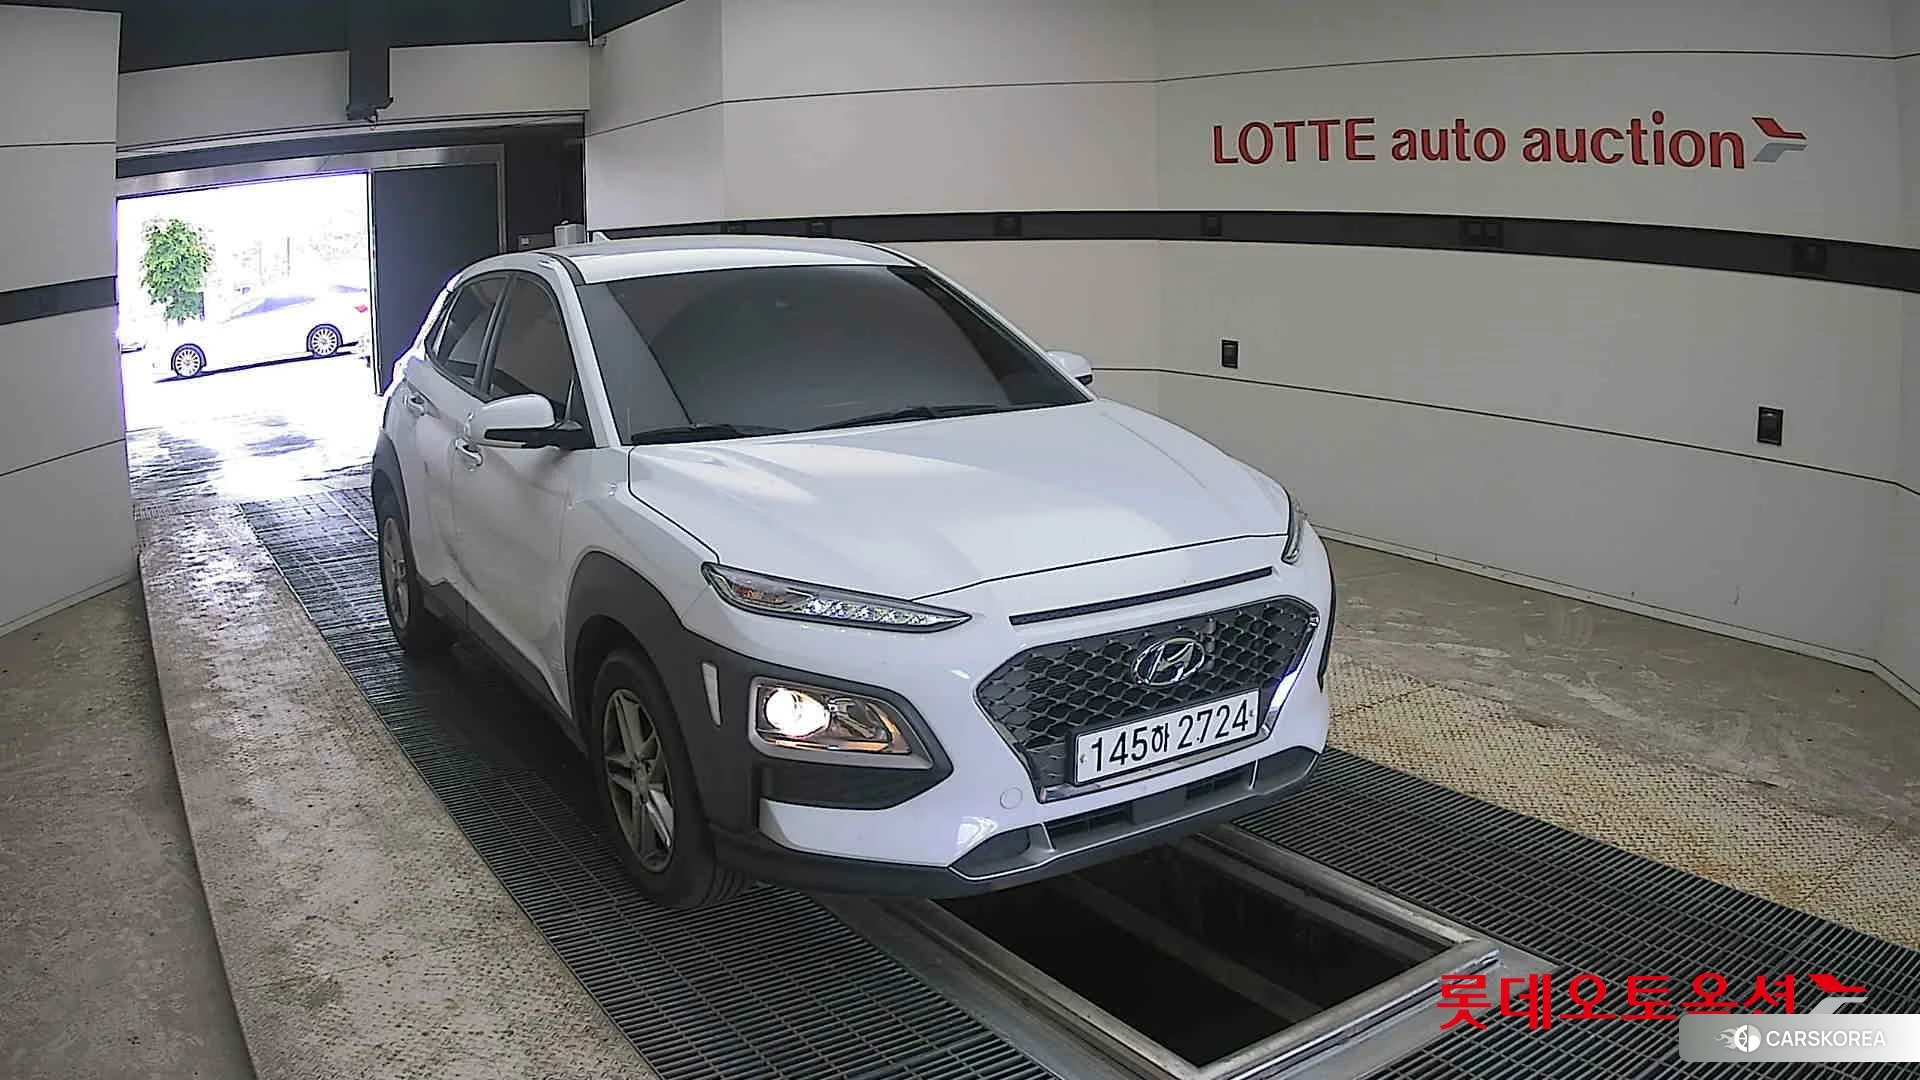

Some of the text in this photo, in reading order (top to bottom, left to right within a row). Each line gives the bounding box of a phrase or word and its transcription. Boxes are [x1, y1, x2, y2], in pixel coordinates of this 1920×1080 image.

[1212, 110, 1745, 169] LOTTE auto auction
